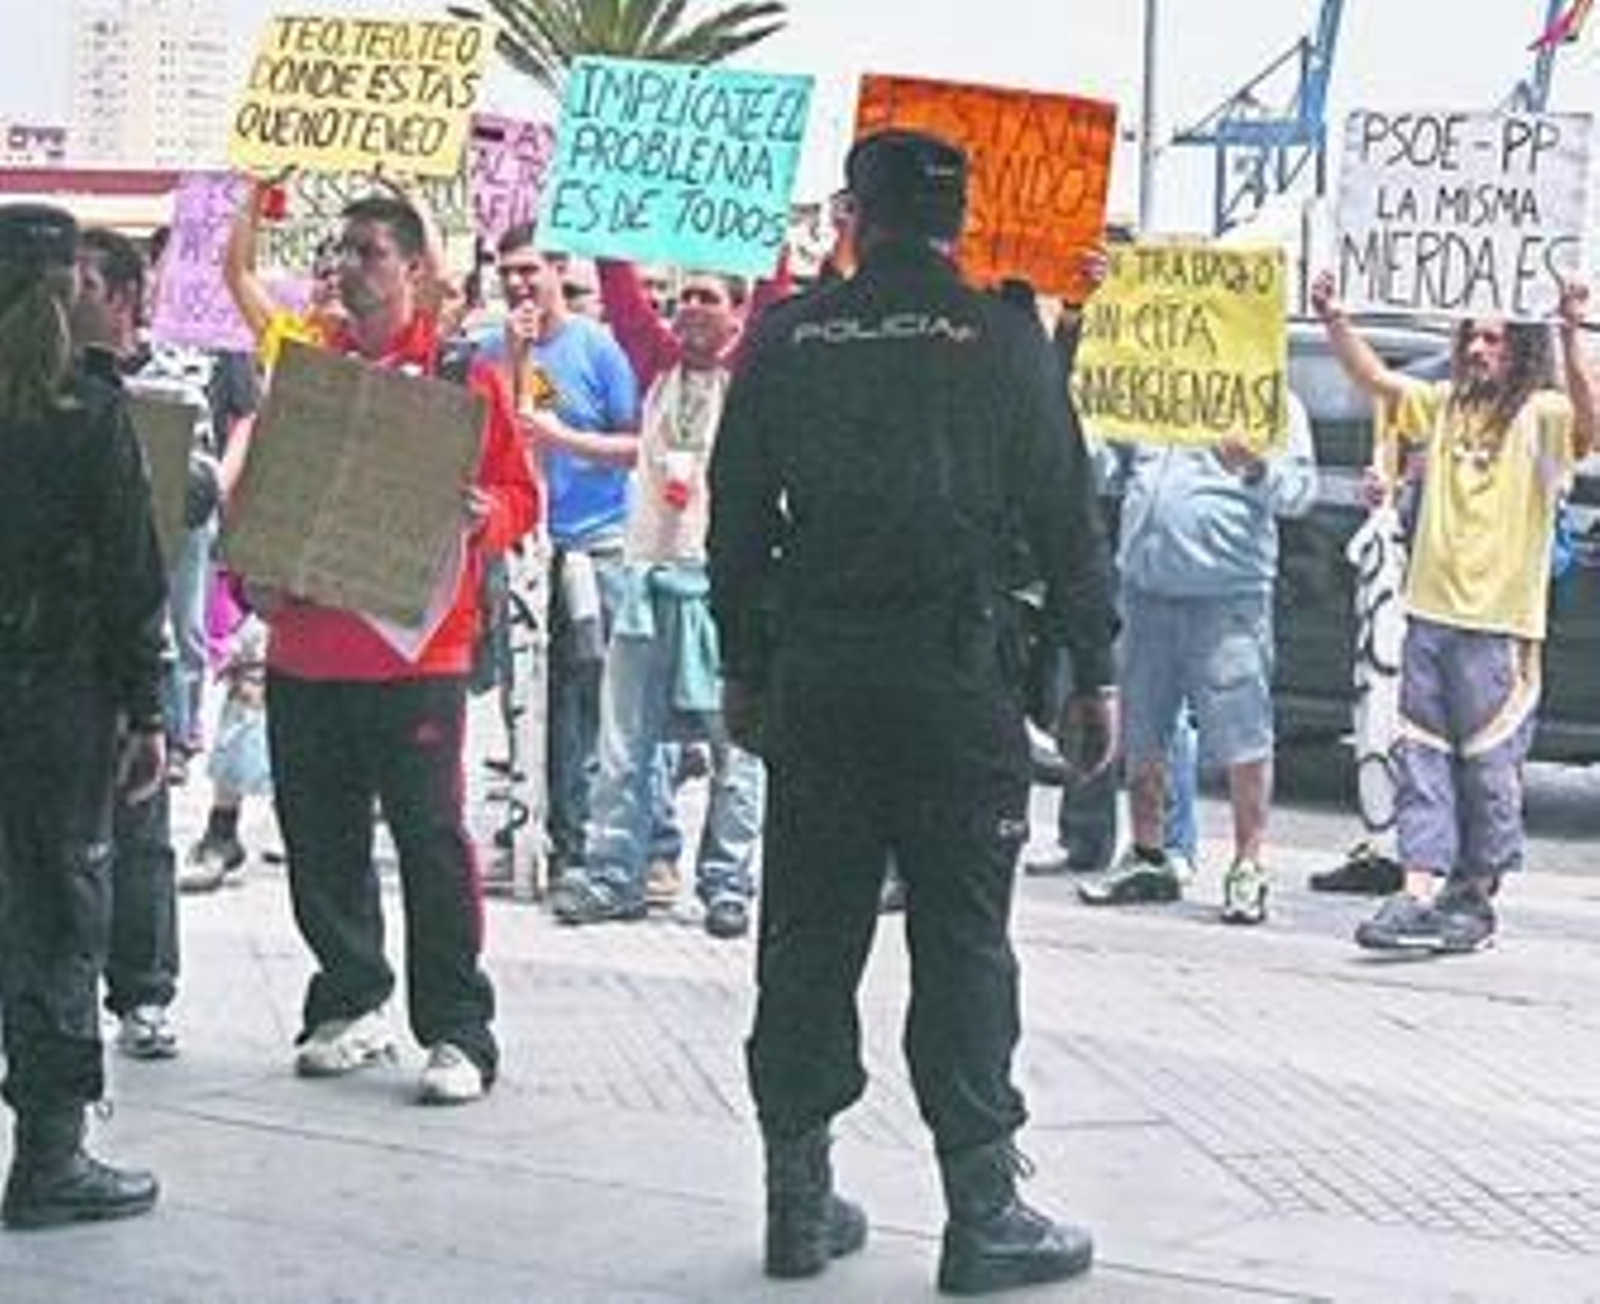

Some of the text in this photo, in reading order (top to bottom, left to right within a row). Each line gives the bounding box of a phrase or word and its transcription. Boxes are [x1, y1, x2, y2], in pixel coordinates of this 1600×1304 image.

[569, 122, 774, 191] PROBLEMA
[550, 178, 603, 233] ES
[608, 187, 664, 233] DE
[672, 187, 787, 248] TODOS
[1377, 183, 1540, 227] LA MISMA
[1341, 229, 1502, 309] MIERDA
[1134, 302, 1218, 355] CITA
